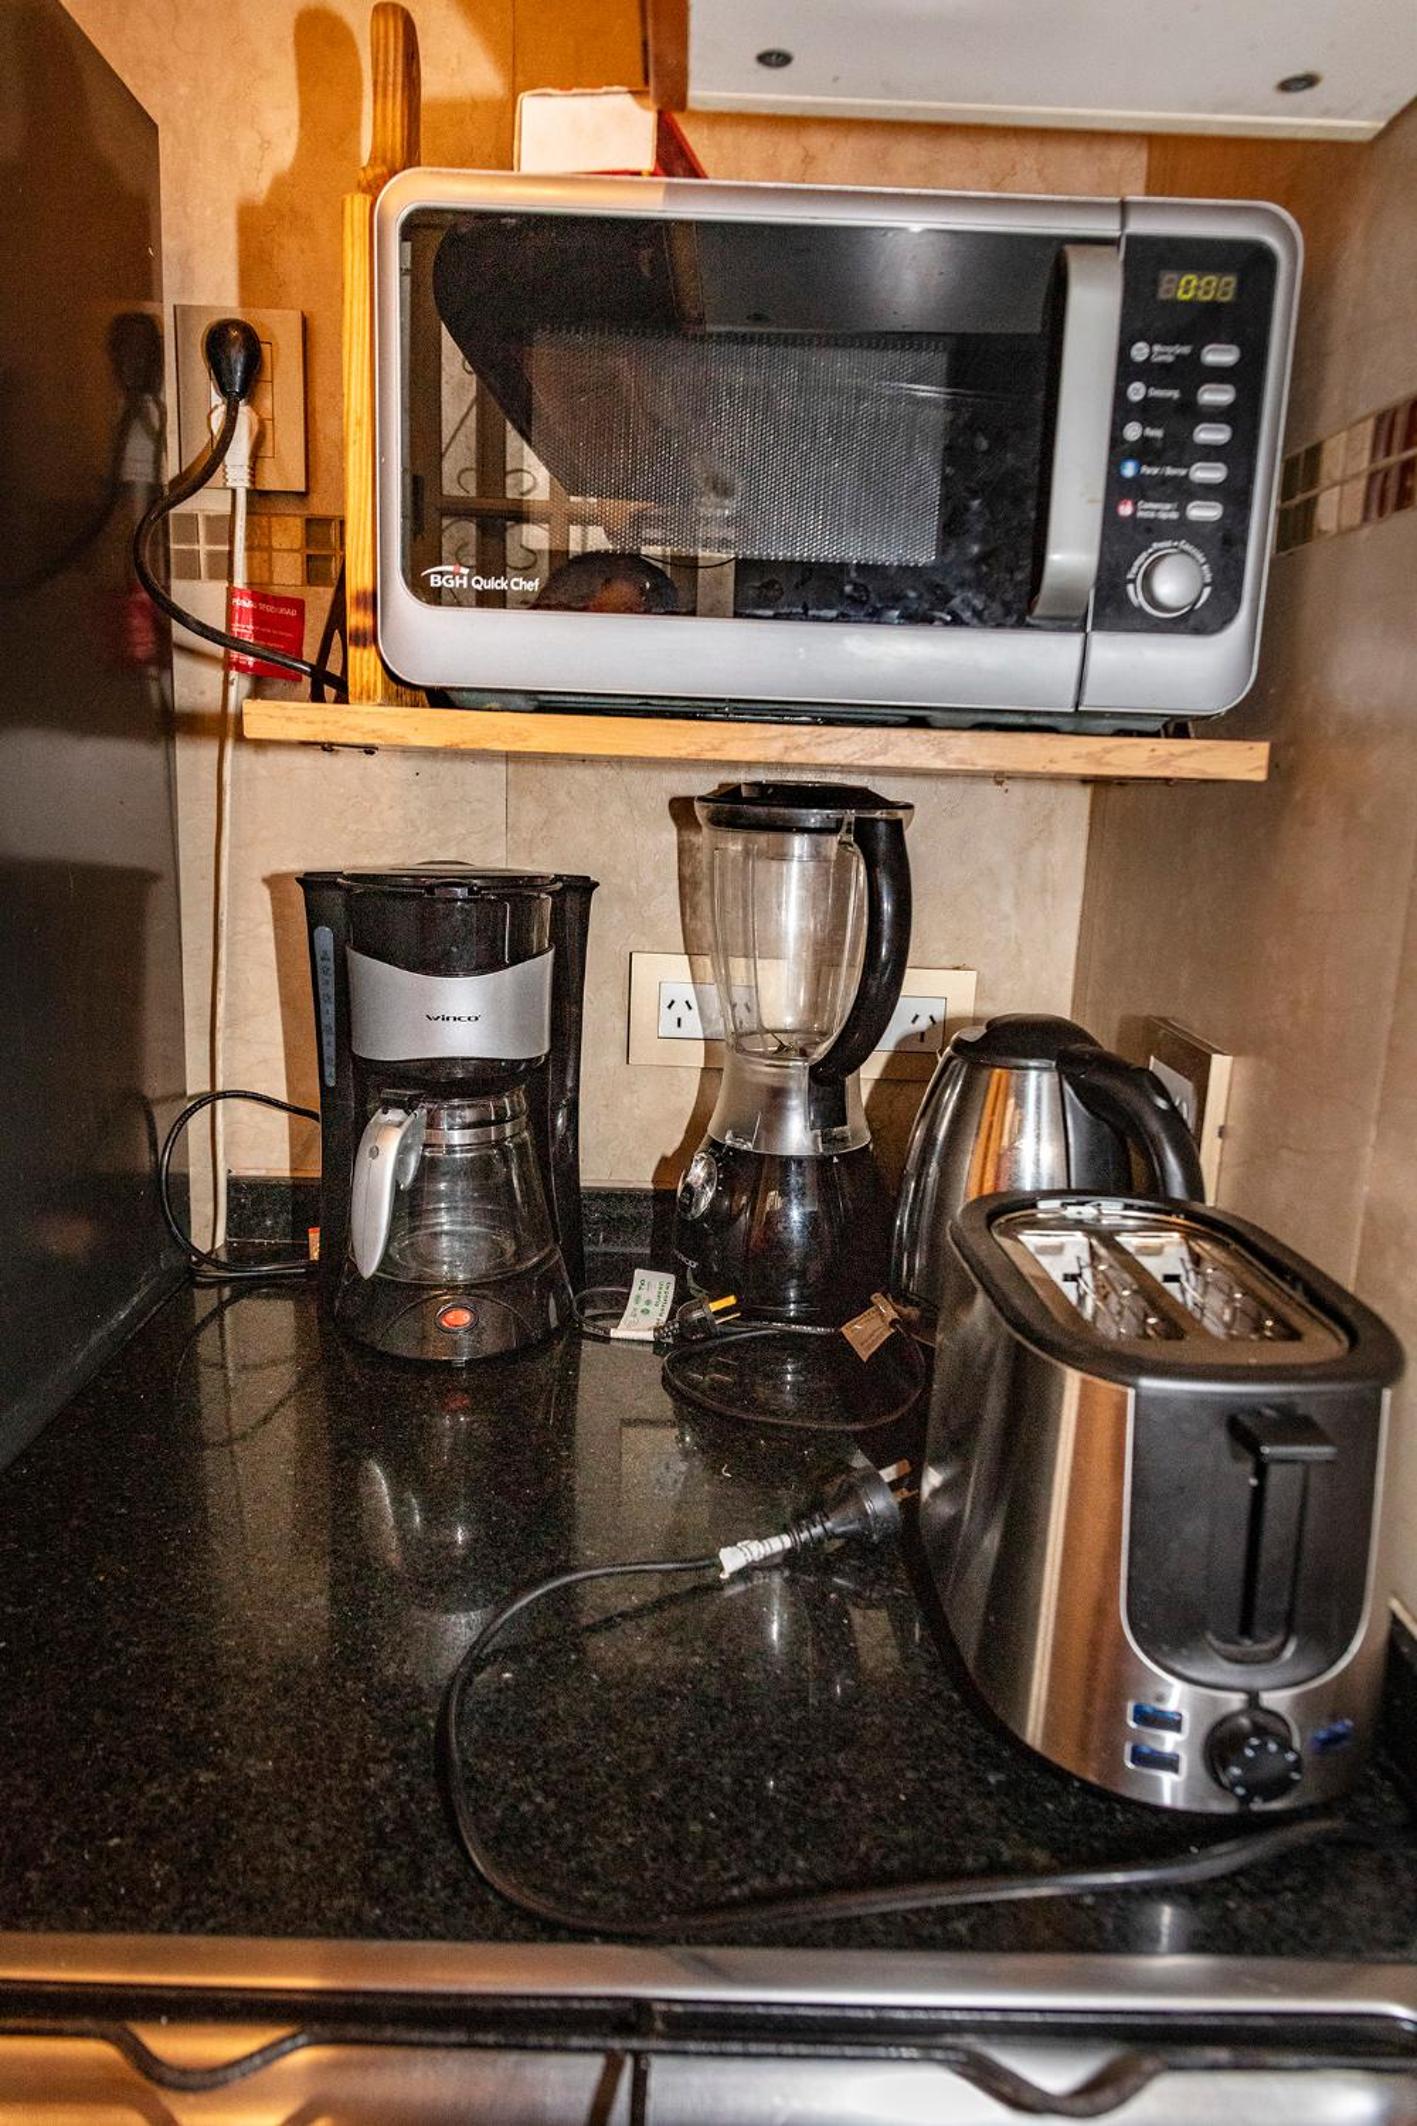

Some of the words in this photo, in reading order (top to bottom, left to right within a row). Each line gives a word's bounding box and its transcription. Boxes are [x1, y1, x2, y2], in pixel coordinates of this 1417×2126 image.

[430, 574, 468, 589] BGH
[471, 575, 508, 591] Quick
[510, 577, 540, 592] Chef
